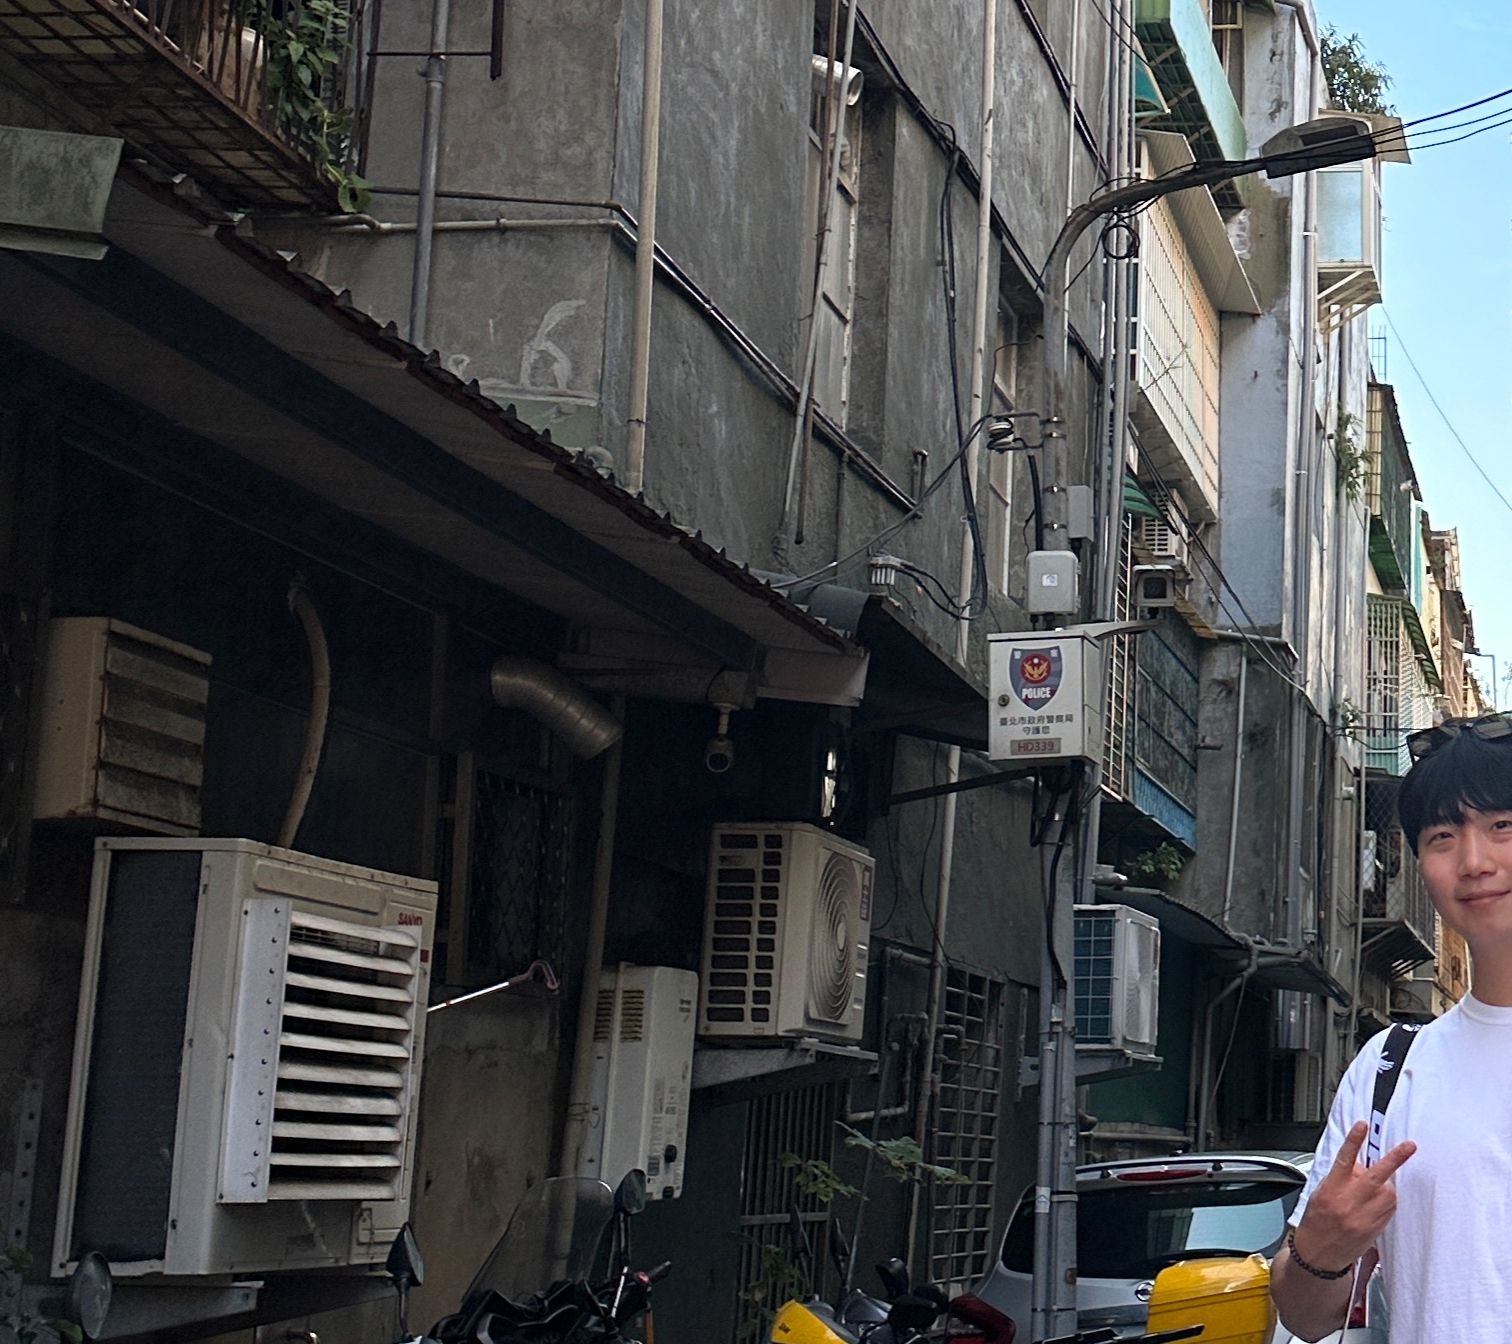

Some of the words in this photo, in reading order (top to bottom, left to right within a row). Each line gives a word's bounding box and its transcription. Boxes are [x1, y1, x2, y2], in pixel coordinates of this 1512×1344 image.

[1022, 687, 1051, 699] POLICE
[1017, 741, 1055, 753] HD339
[398, 912, 423, 926] SANYO
